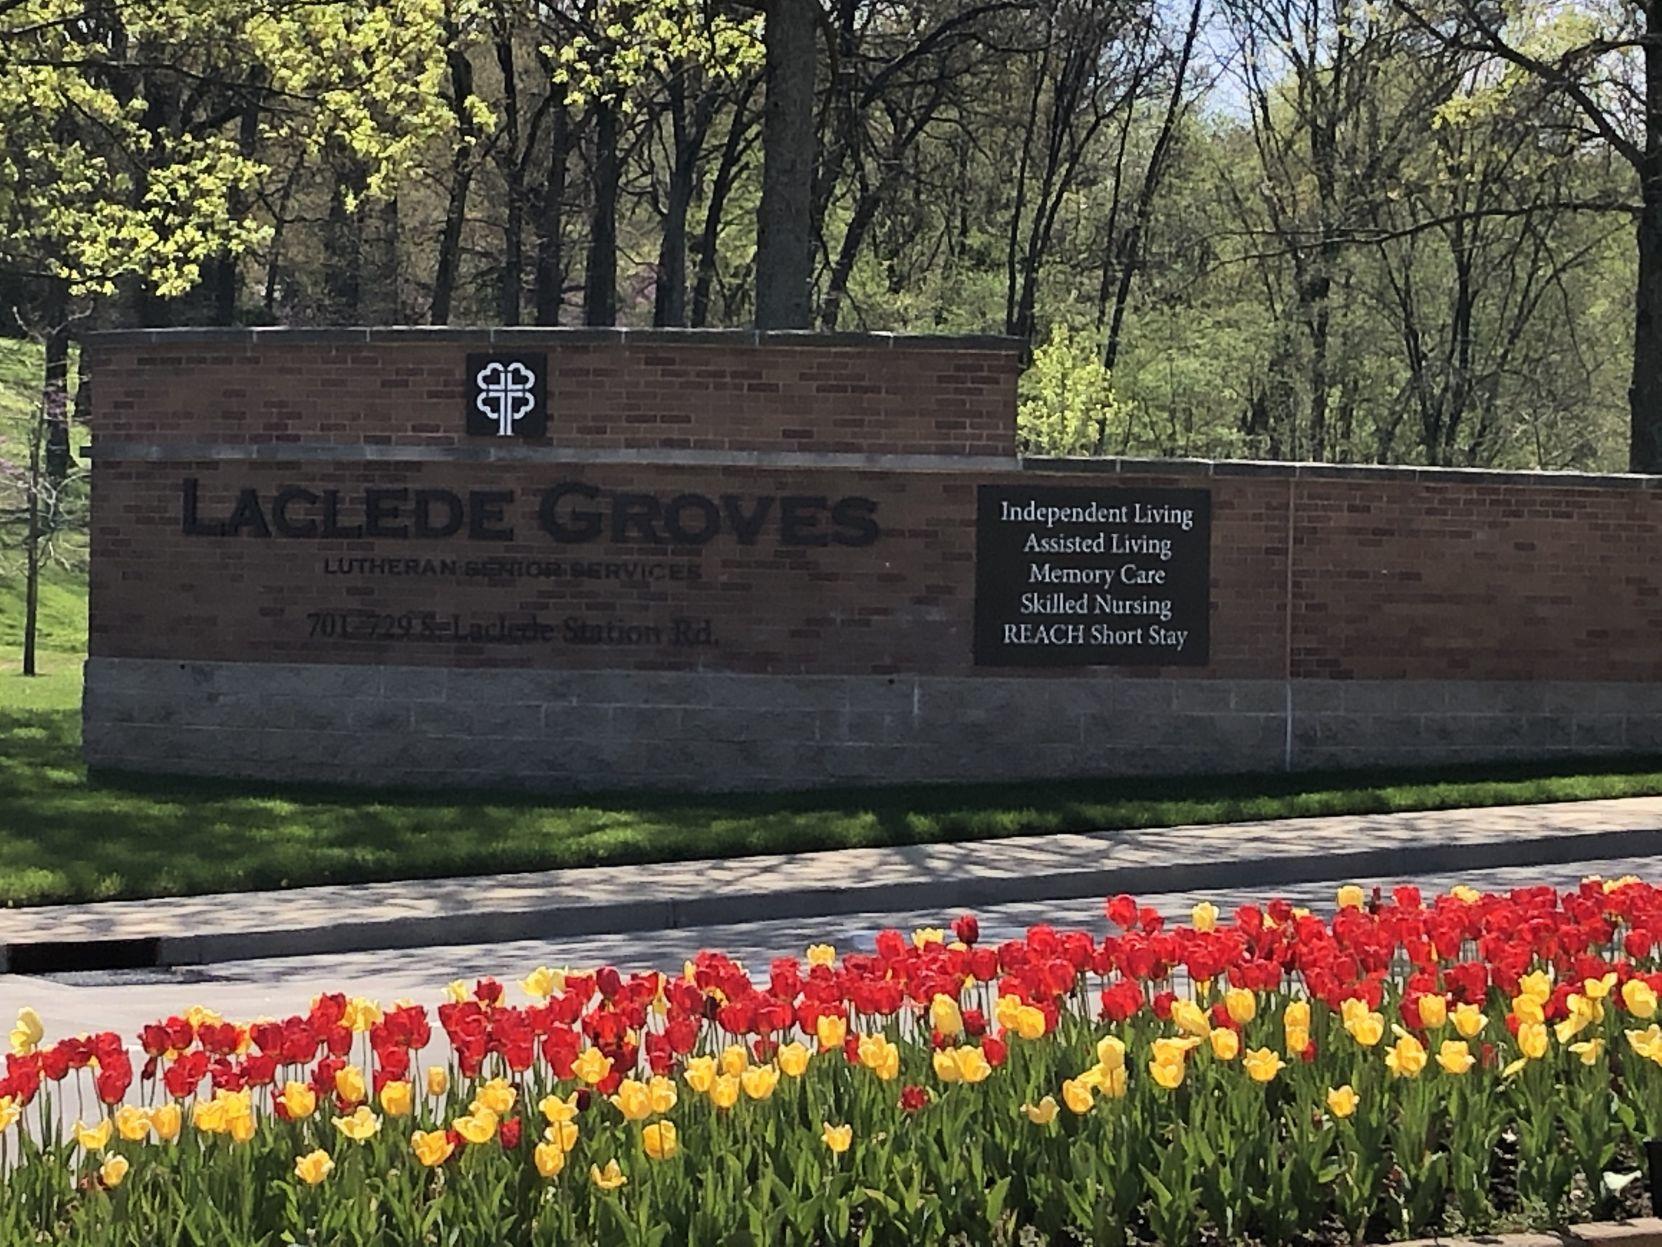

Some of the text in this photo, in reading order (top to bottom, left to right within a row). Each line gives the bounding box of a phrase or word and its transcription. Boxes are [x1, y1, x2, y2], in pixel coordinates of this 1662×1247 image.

[1001, 501, 1193, 531] Independent Living
[1023, 532, 1172, 561] Assisted Living
[324, 558, 702, 581] LUTHERAN SENIOR SERVICES
[1028, 563, 1166, 590] Memory Care
[1020, 592, 1172, 621] Skilled Nursing
[453, 613, 554, 643] Laclede
[563, 617, 662, 645] Station
[672, 618, 719, 646] Rd.
[1003, 623, 1188, 651] REACH Short Stay
